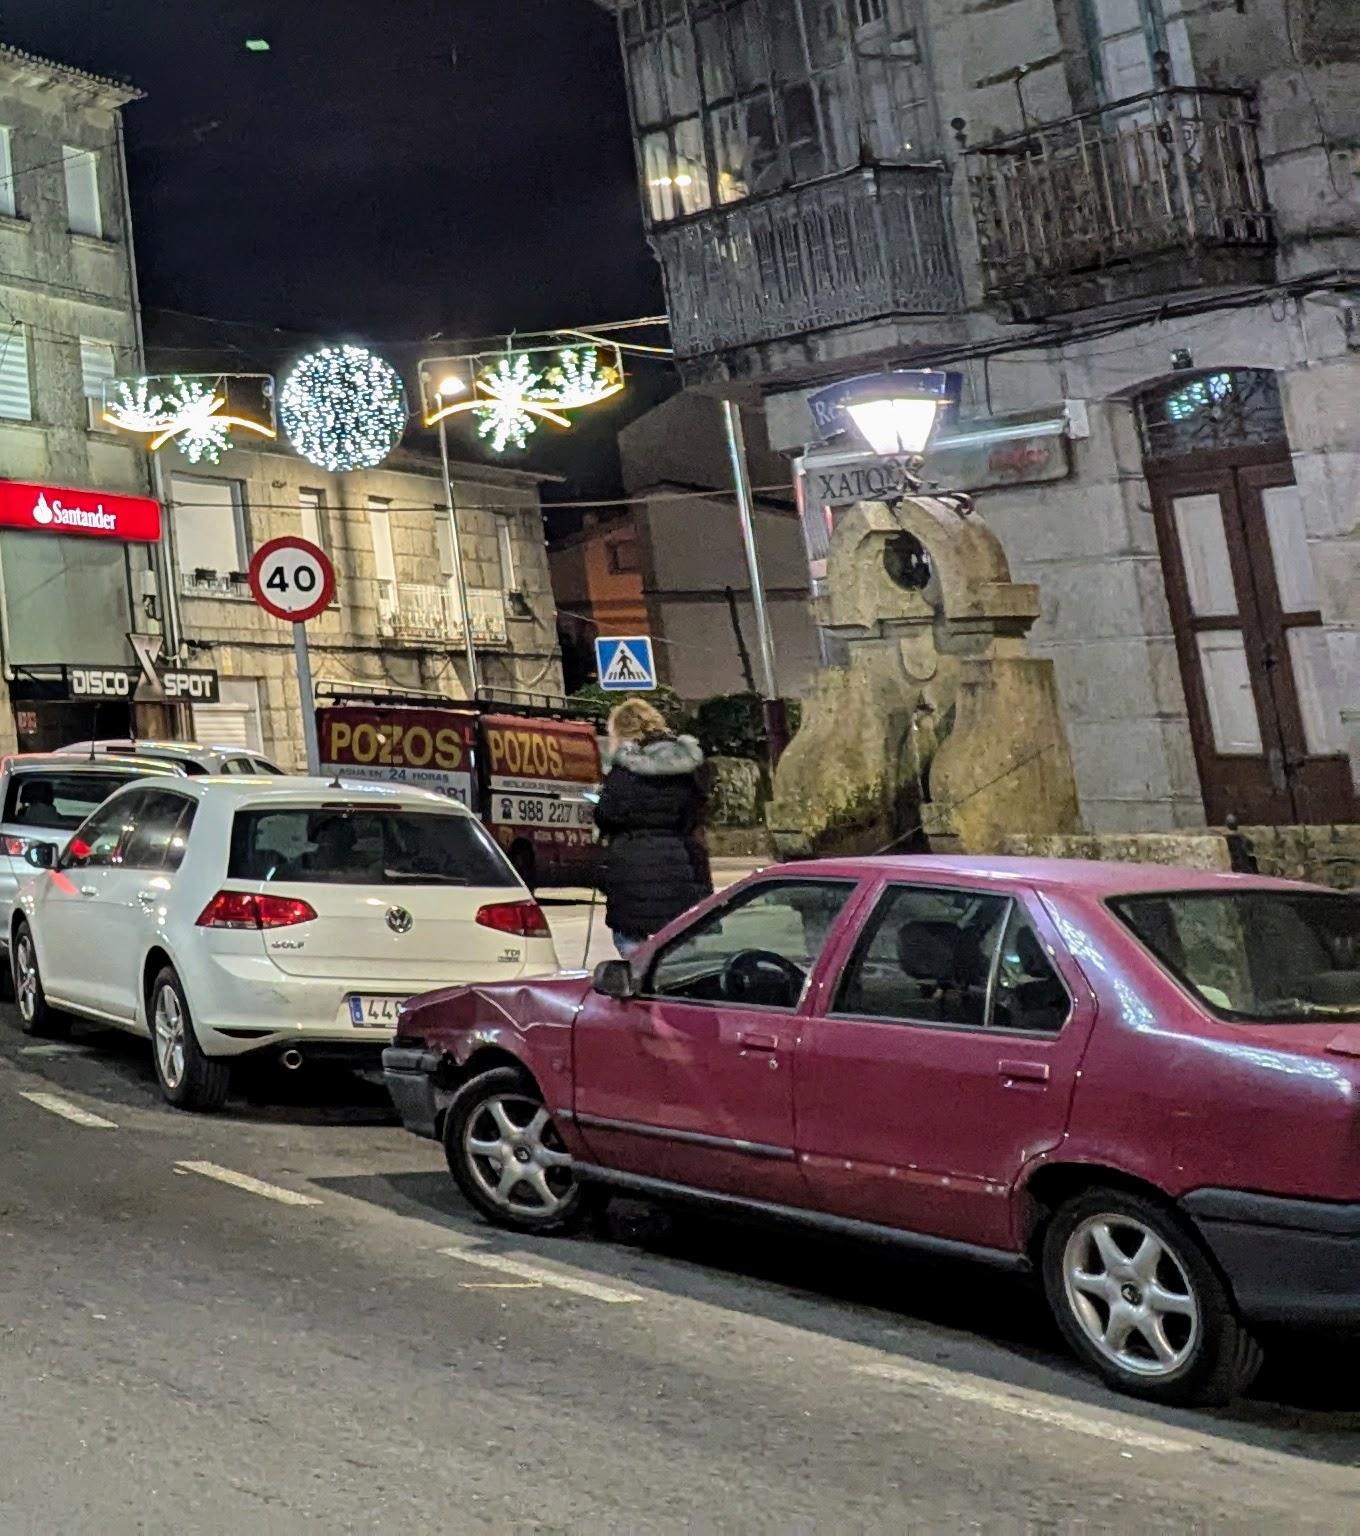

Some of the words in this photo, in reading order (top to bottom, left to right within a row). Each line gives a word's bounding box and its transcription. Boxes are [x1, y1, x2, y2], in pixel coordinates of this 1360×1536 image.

[52, 500, 117, 530] Santander
[266, 565, 316, 593] 40
[72, 670, 129, 696] DISCO
[163, 673, 213, 697] SPOT
[331, 722, 463, 768] POZOS
[489, 729, 564, 777] POZOS
[389, 768, 407, 781] 24
[412, 771, 449, 783] HORAS
[518, 799, 544, 822] 988
[548, 802, 573, 823] 227
